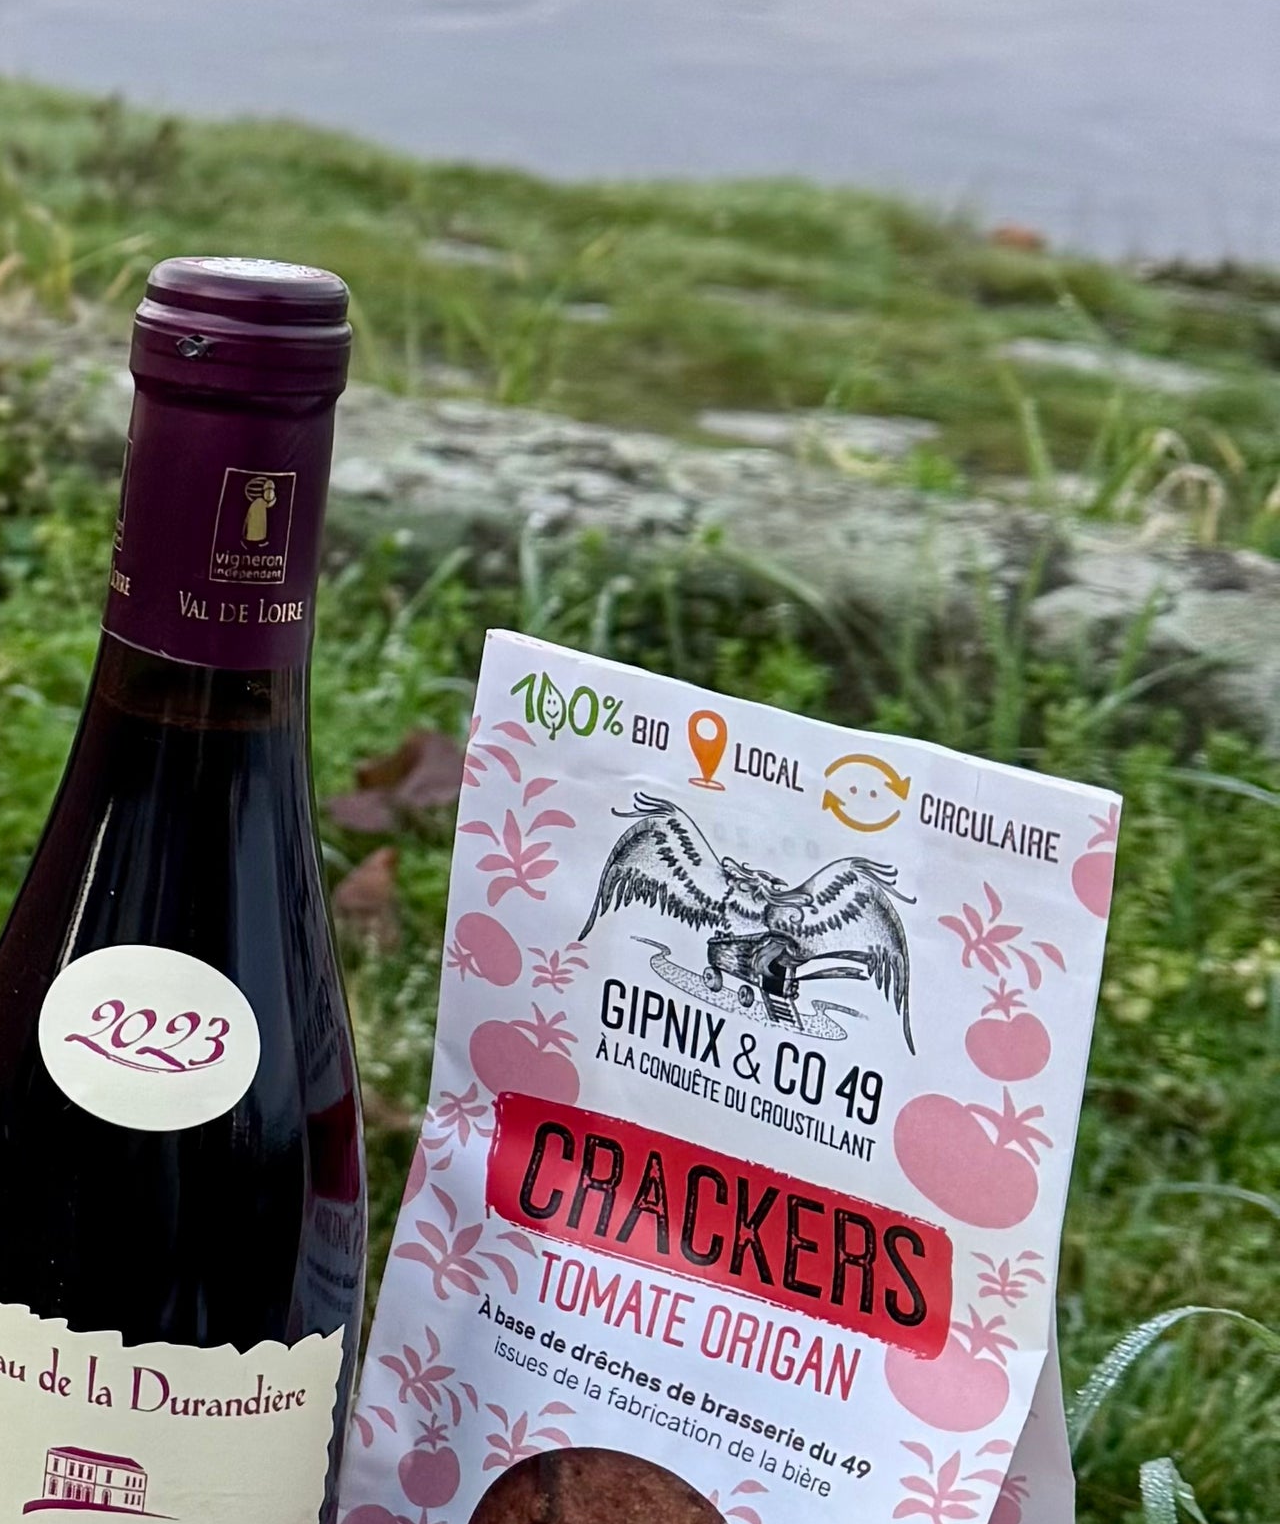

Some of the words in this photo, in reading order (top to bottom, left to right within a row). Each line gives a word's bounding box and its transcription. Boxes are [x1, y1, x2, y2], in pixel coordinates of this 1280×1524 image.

[216, 550, 283, 569] vigneron
[179, 590, 209, 620] VAL
[219, 602, 248, 623] DE
[258, 599, 304, 623] LOIRE
[631, 715, 671, 752] BIO
[733, 743, 806, 793] LOCAL
[919, 792, 1062, 864] CIRCULAIRE
[64, 999, 230, 1073] 2023
[599, 977, 726, 1069] GIPNIX
[733, 1032, 763, 1084] &
[773, 1040, 827, 1106] CO
[835, 1065, 884, 1127] 49
[595, 1032, 611, 1061] À
[614, 1040, 636, 1066] LA
[639, 1049, 721, 1103] CONQUÊTE
[723, 1086, 746, 1111] DU
[749, 1094, 877, 1163] CROUSTILLANT
[518, 1121, 928, 1327] CRACKERS
[538, 1249, 696, 1349] TOMATE
[701, 1304, 861, 1402] ORIGAN
[39, 1348, 71, 1397] de
[87, 1355, 113, 1408] la
[478, 1293, 492, 1318] À
[493, 1307, 537, 1341] base
[539, 1327, 567, 1355] de
[570, 1341, 662, 1394] drêches
[666, 1381, 696, 1407] de
[701, 1393, 806, 1453] brasserie
[808, 1441, 838, 1467] du
[840, 1454, 873, 1480] 49
[493, 1334, 551, 1375] issues
[552, 1364, 580, 1390] de
[583, 1375, 602, 1401] la
[606, 1386, 722, 1451] fabrication
[726, 1439, 755, 1465] de
[759, 1452, 779, 1473] la
[782, 1460, 833, 1498] bière
